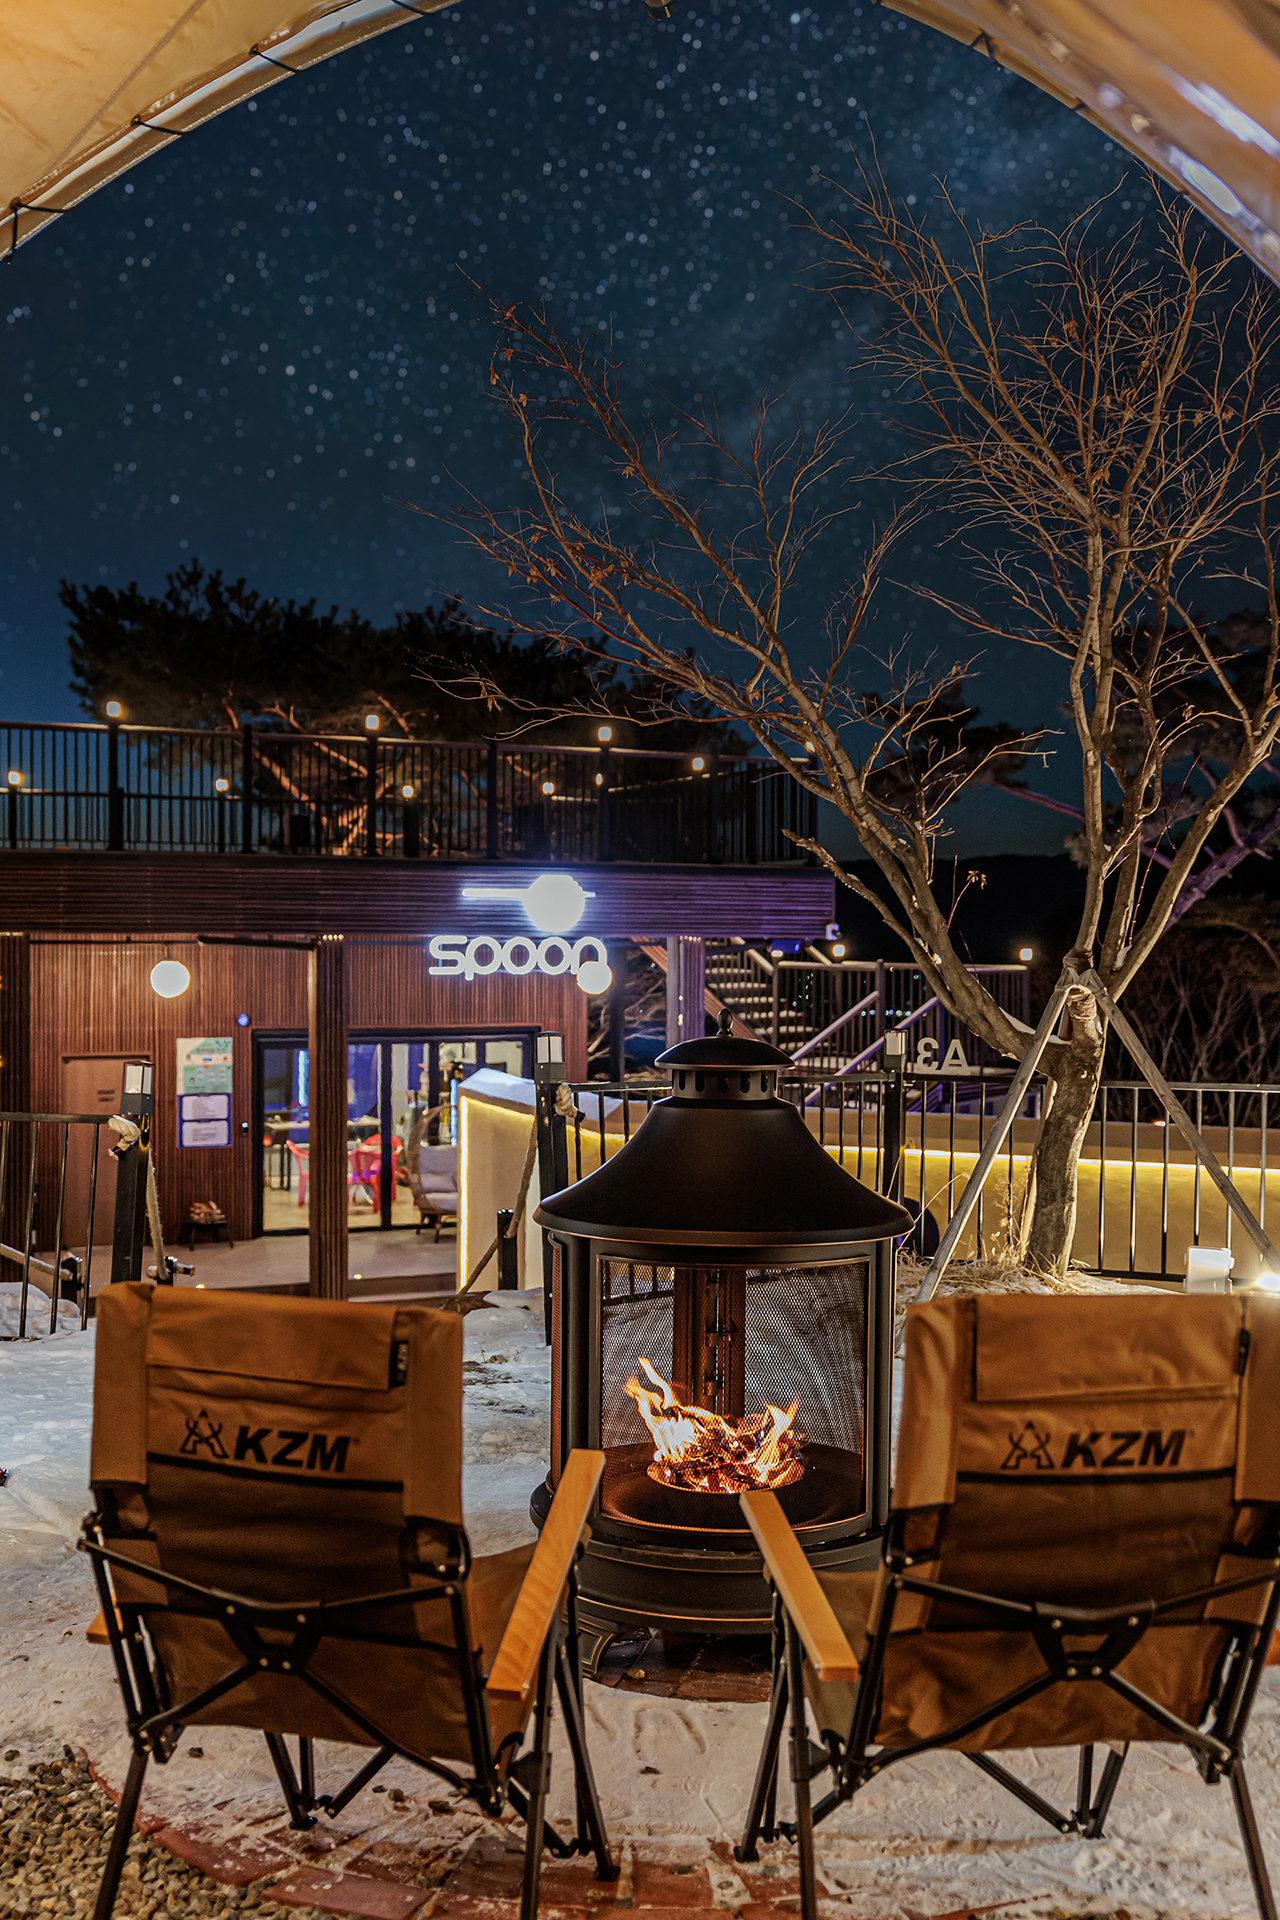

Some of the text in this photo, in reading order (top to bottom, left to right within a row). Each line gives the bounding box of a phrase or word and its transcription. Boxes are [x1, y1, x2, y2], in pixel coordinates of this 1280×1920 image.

[429, 935, 608, 981] spoon
[234, 1425, 350, 1473] KZM
[1061, 1429, 1186, 1468] KZM
